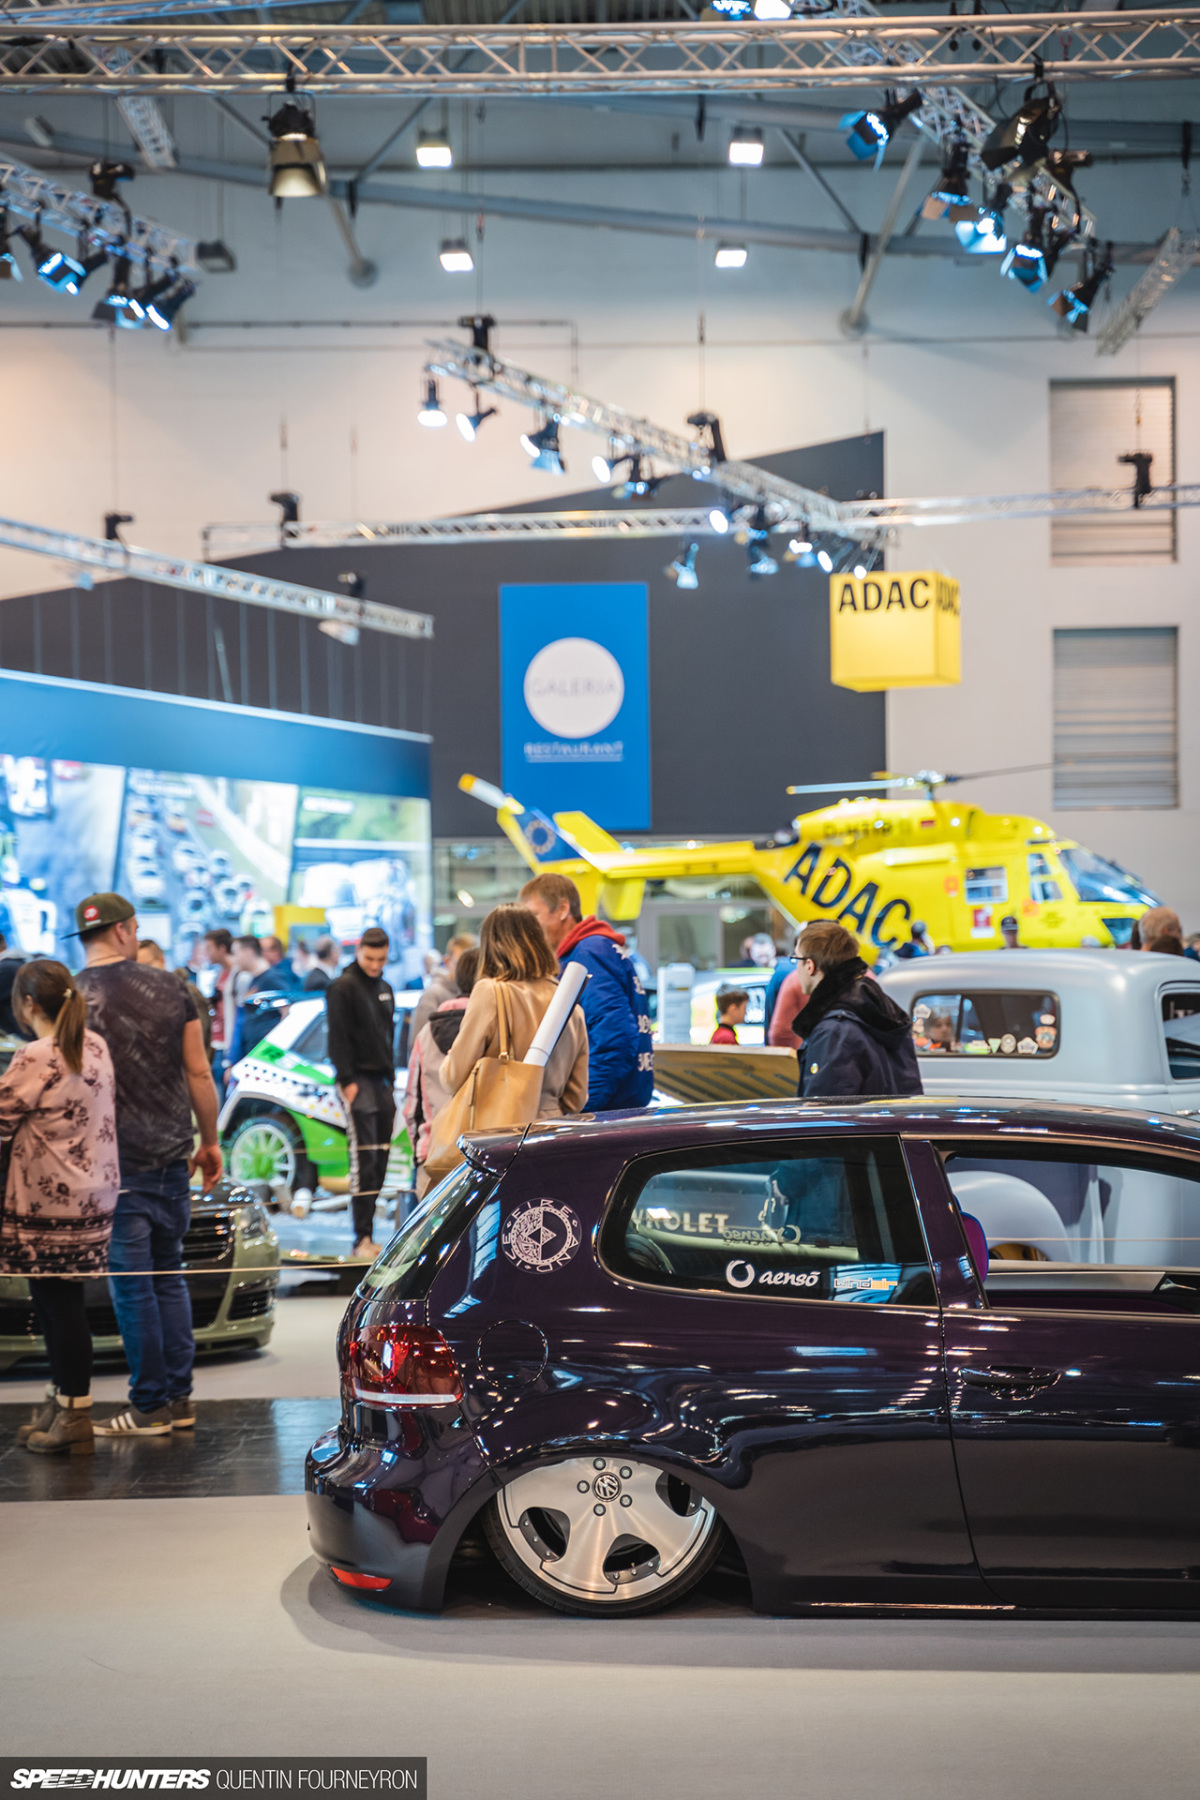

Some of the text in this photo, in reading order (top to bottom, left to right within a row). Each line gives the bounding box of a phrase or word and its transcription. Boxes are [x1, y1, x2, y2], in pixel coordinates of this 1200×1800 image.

[838, 578, 929, 612] ADAC
[530, 677, 618, 697] GALERIA
[783, 842, 911, 947] ADAC
[511, 1198, 573, 1219] FIRE
